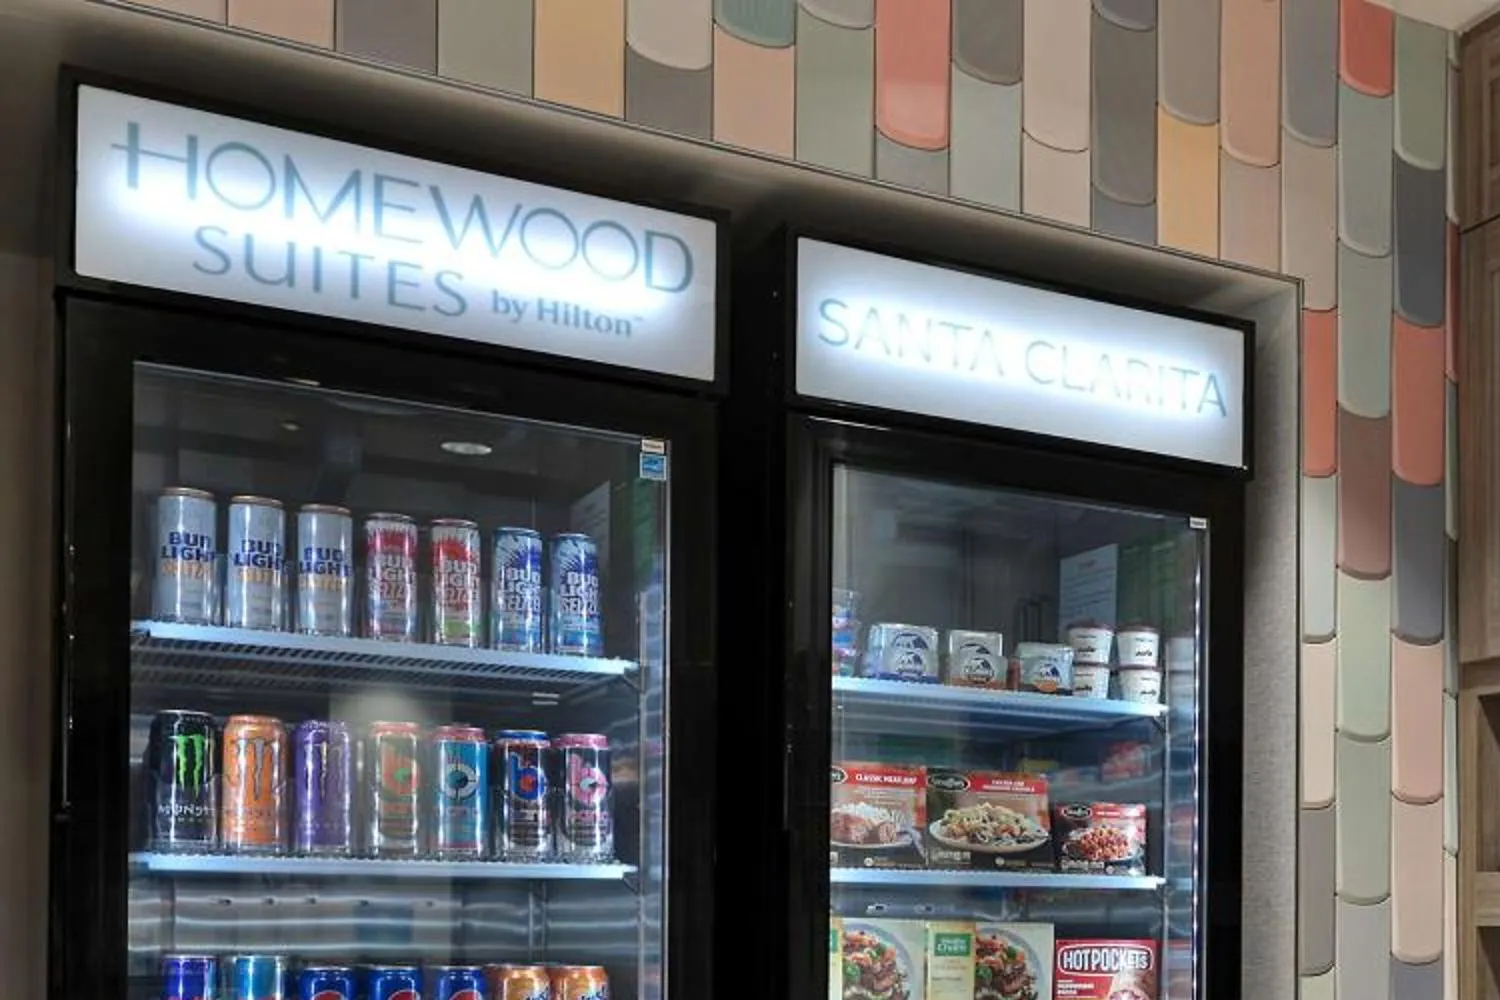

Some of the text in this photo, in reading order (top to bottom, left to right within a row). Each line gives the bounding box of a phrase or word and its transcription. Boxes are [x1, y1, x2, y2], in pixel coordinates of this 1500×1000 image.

[110, 121, 694, 294] HOMEWOOD
[192, 226, 633, 338] SUITES by Hilton
[818, 298, 1228, 418] SANTA CLARITA
[1063, 948, 1149, 972] HOT POCKETS
